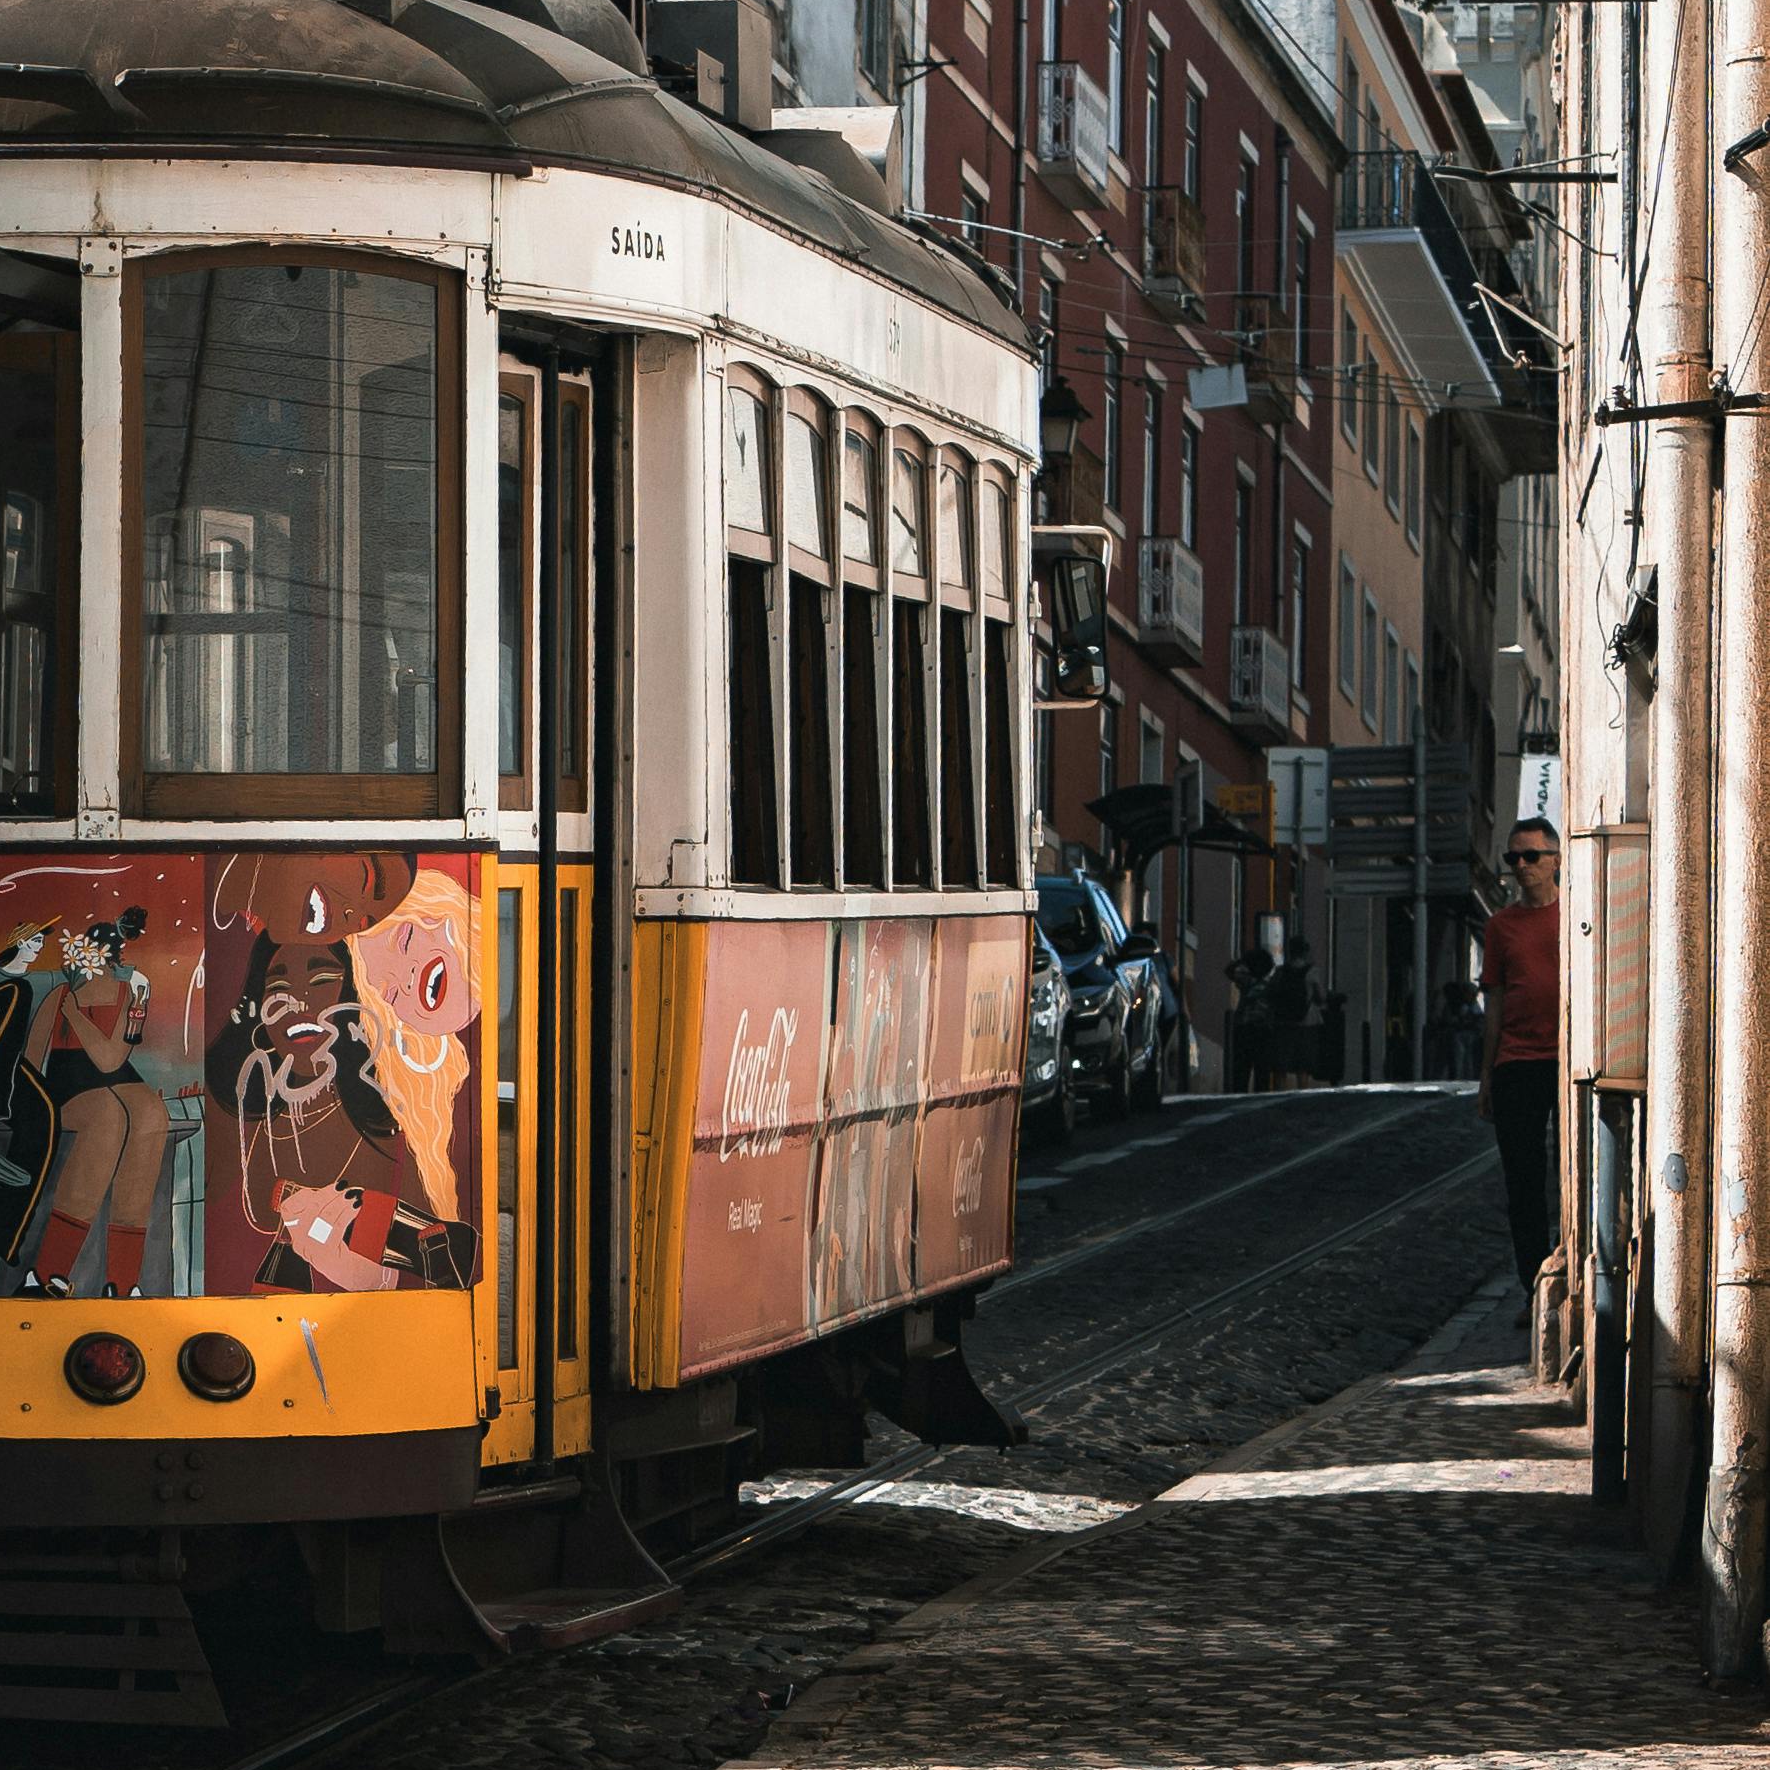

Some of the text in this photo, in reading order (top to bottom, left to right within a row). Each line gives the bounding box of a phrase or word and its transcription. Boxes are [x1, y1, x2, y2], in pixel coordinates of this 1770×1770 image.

[611, 220, 665, 261] SAÍDA
[720, 1007, 799, 1164] Coca-Cola
[727, 1198, 744, 1232] Real
